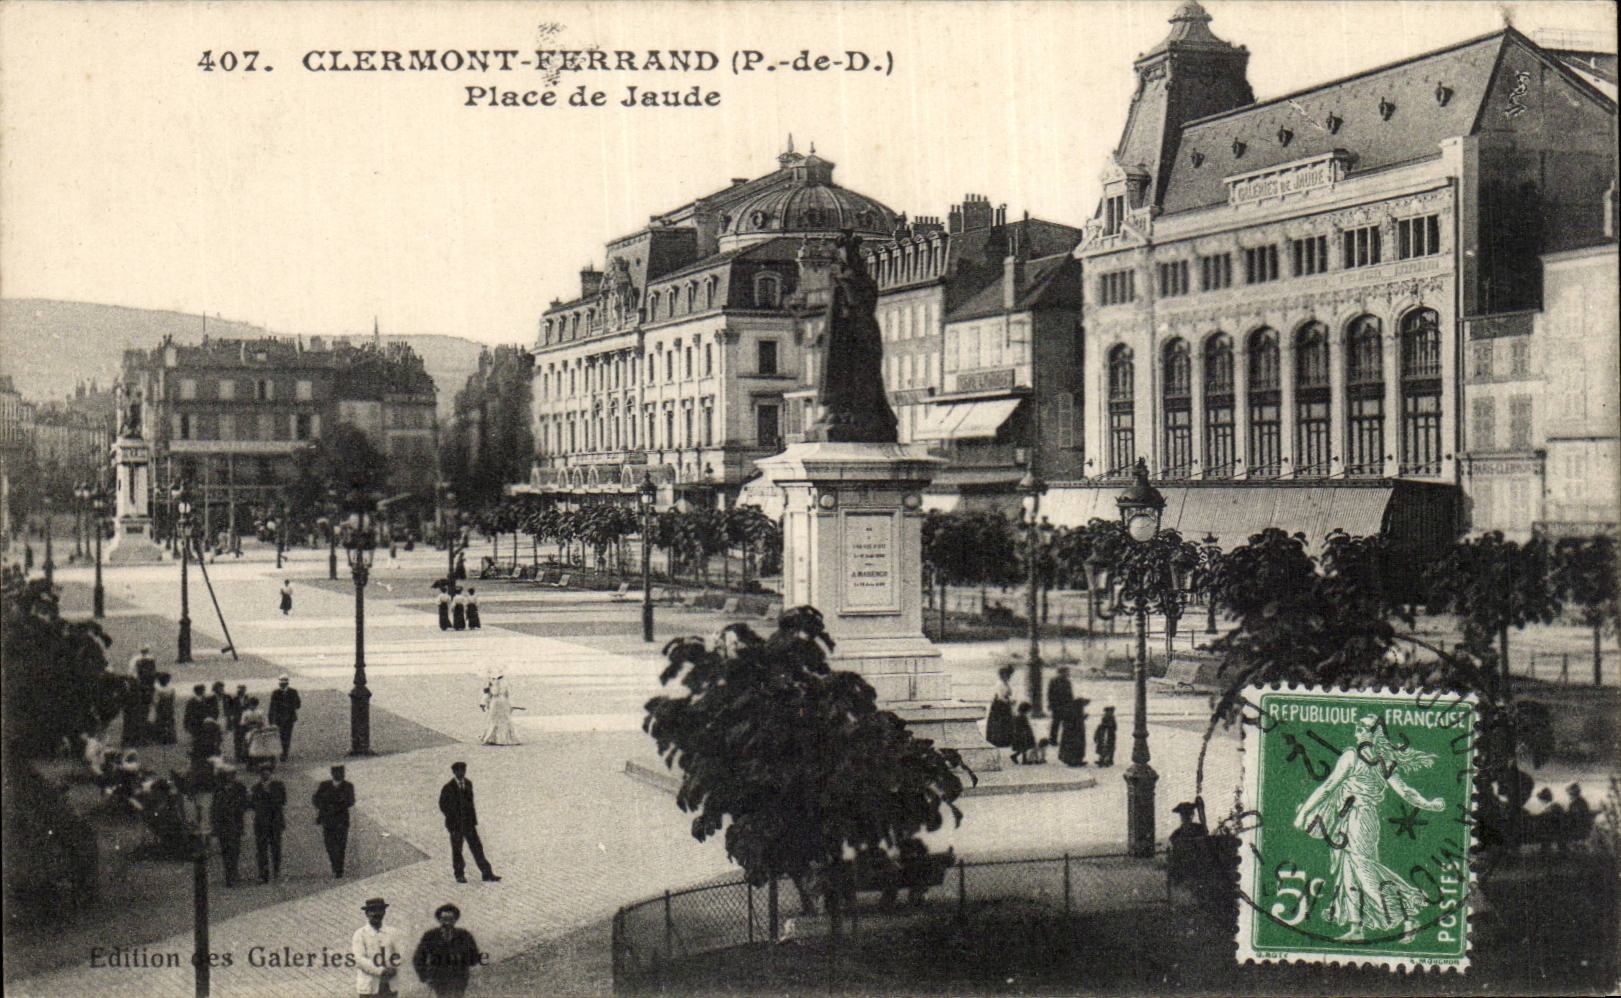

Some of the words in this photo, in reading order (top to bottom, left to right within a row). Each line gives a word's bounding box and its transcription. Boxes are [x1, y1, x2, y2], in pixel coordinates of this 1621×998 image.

[1293, 168, 1325, 191] JAUDE
[1268, 702, 1359, 726] REPUBLIQUE
[1385, 707, 1467, 730] FRANÇAISE
[1438, 860, 1463, 944] POSTES
